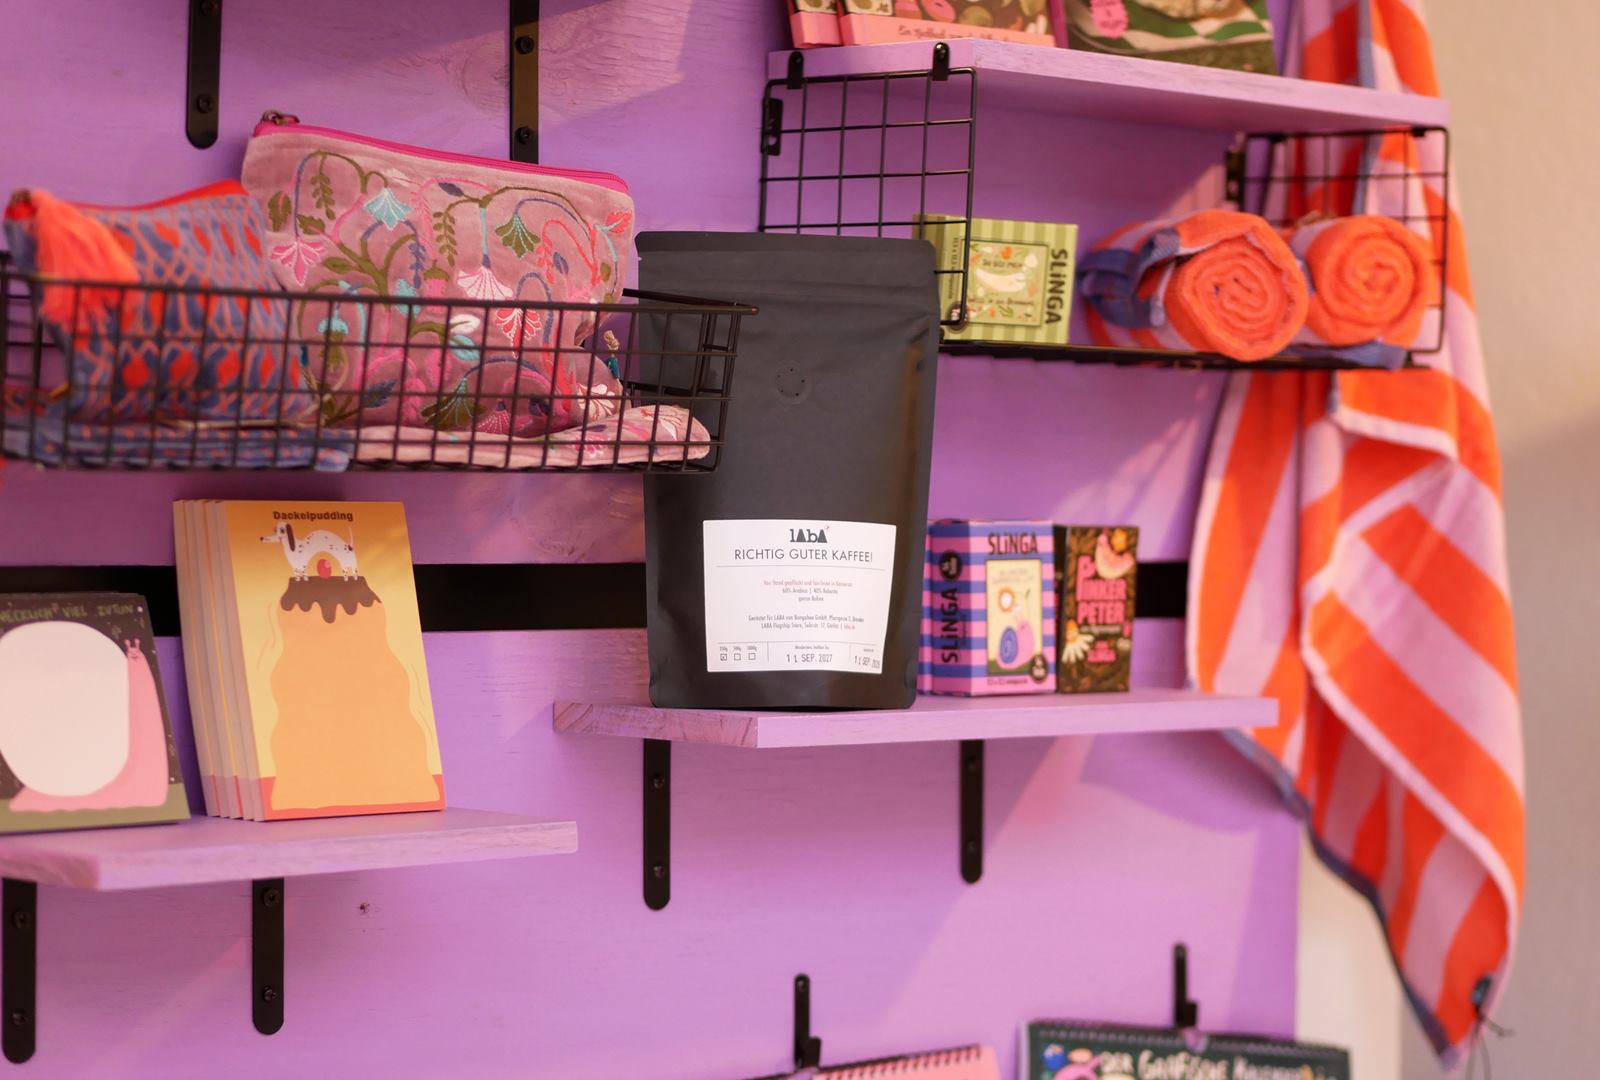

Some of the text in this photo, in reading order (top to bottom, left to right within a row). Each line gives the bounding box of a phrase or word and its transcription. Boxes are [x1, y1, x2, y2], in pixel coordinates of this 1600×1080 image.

[273, 511, 353, 522] Dackelpudding
[734, 548, 873, 563] RICHTIG GUTER KAFFEE!
[1077, 601, 1126, 625] PETER
